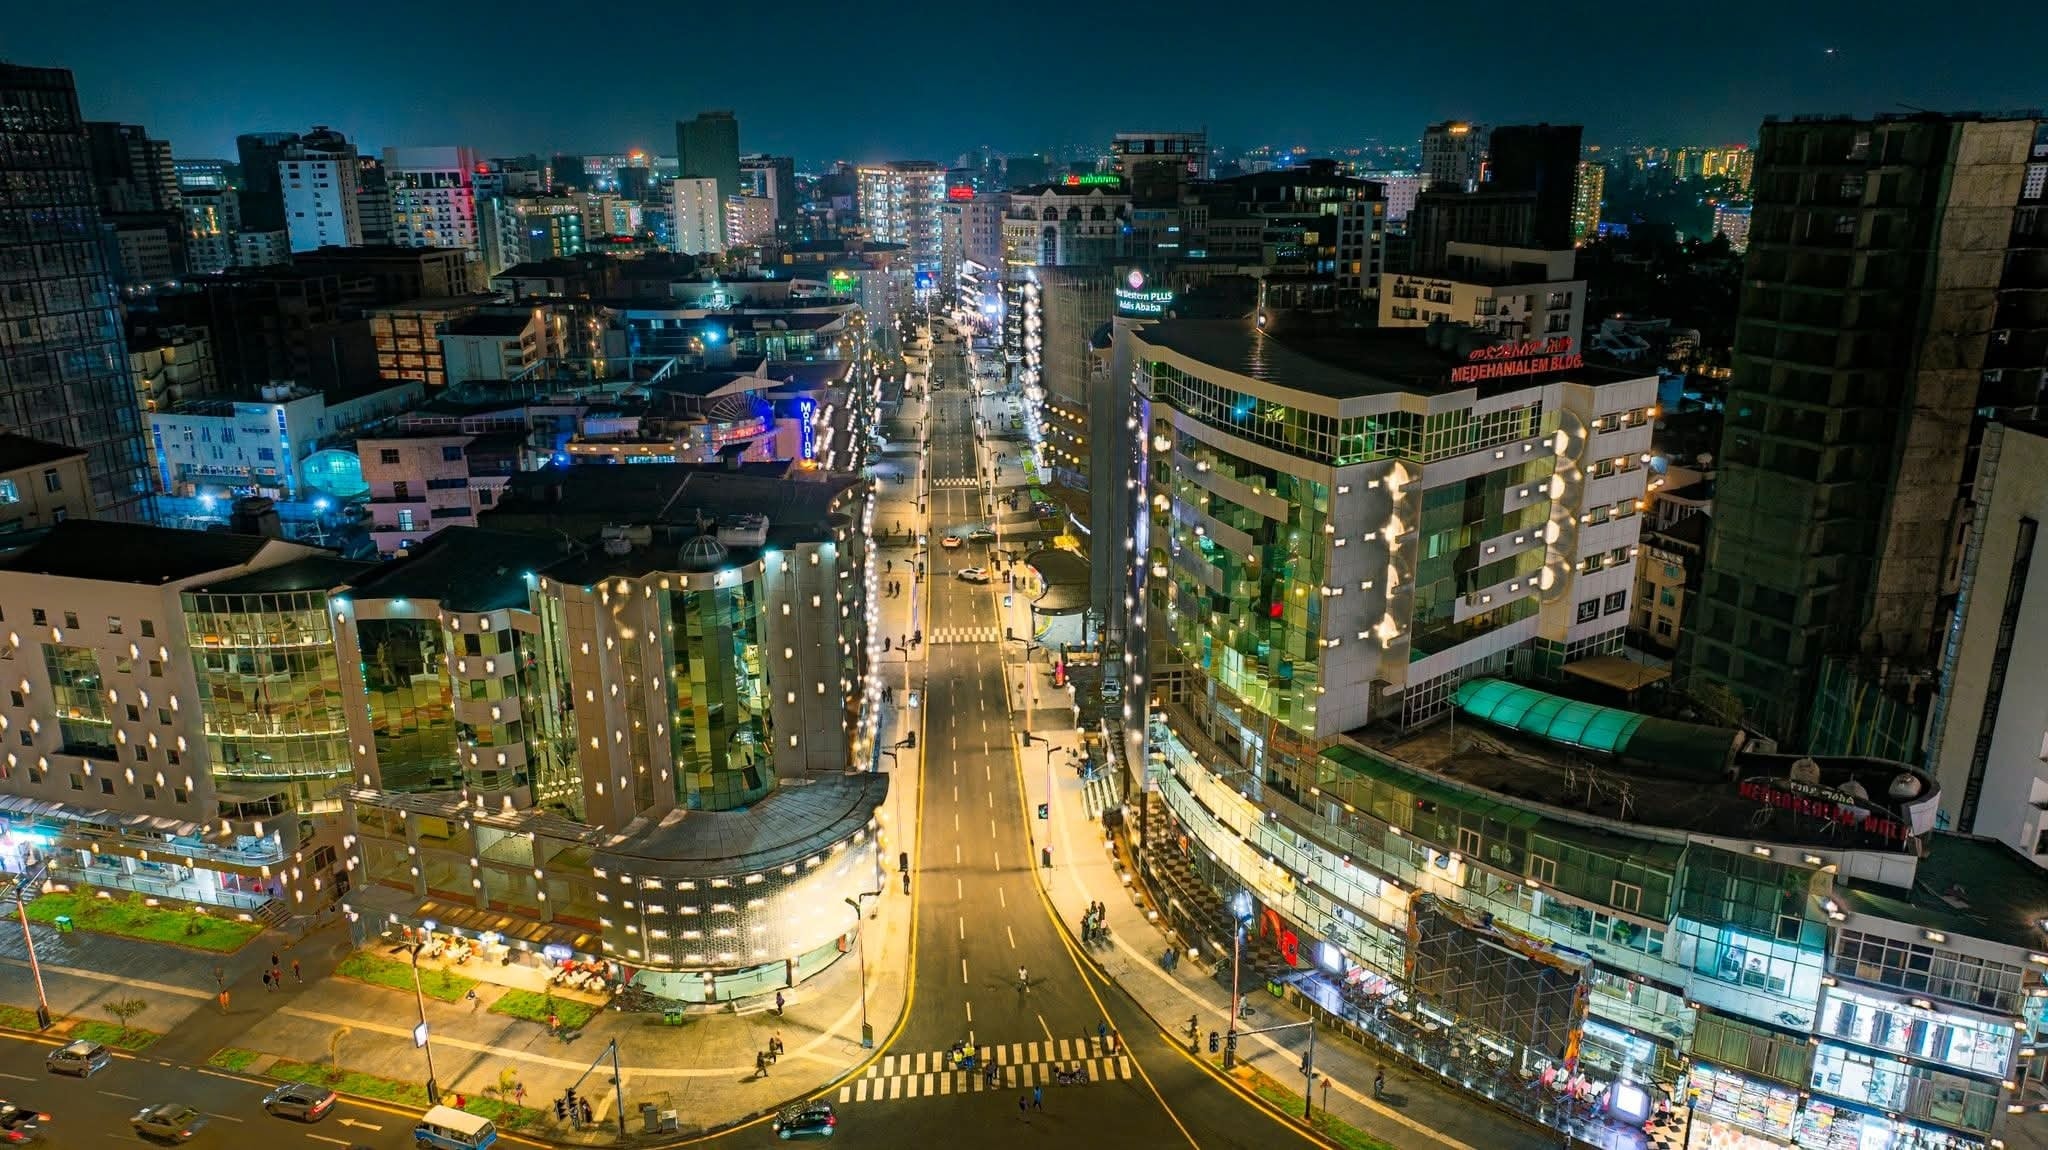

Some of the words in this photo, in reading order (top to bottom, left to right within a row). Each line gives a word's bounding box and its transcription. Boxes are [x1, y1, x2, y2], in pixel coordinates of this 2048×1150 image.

[1150, 291, 1173, 301] PLUS
[1135, 302, 1161, 312] Ababa
[1451, 357, 1549, 383] MEDEHANIALEM
[1550, 354, 1584, 371] BLDG.
